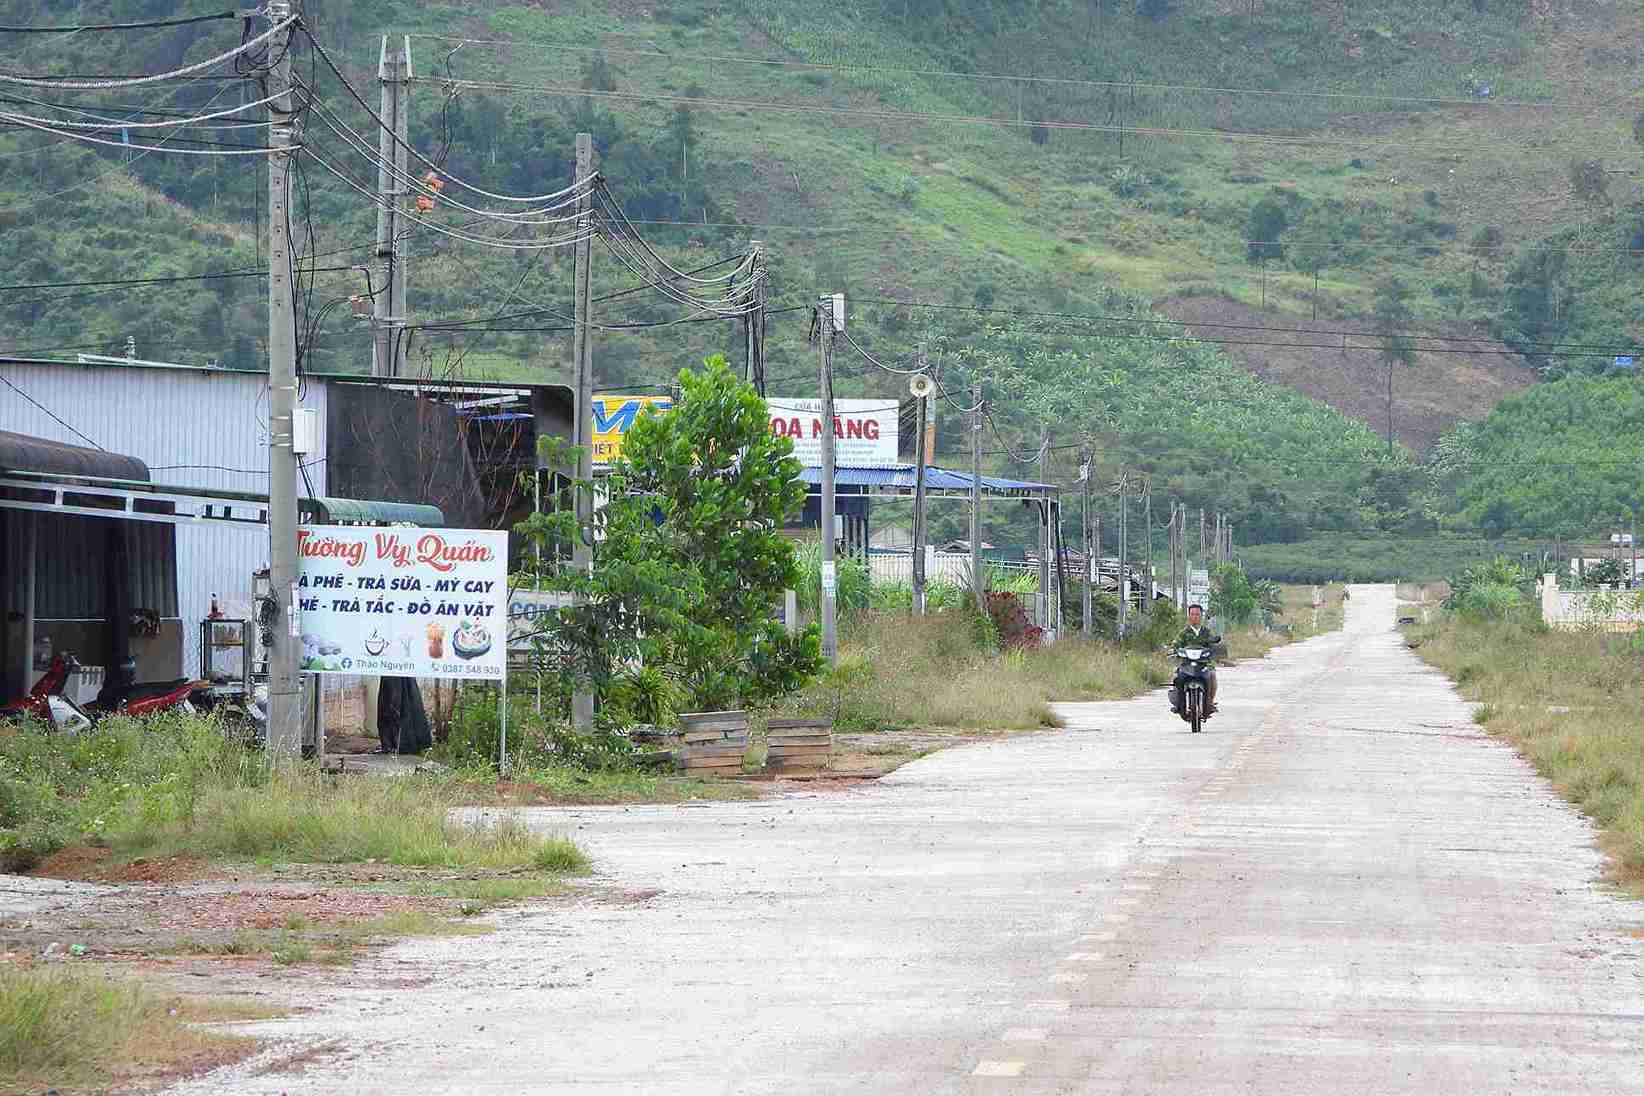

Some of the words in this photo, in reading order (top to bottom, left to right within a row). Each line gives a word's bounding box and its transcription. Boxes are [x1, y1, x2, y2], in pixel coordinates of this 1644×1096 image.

[772, 417, 803, 439] OA
[297, 531, 366, 567] Tường
[417, 534, 490, 572] Quán
[298, 571, 308, 588] À
[312, 573, 344, 589] PHÊ
[357, 574, 386, 590] TRÀ
[390, 575, 421, 591] SỮA
[464, 580, 494, 593] CAY
[299, 595, 319, 611] HÈ
[332, 596, 361, 612] TRÀ
[366, 594, 395, 614] TẮC
[407, 596, 431, 615] ĐỒ
[435, 599, 460, 616] ĂN
